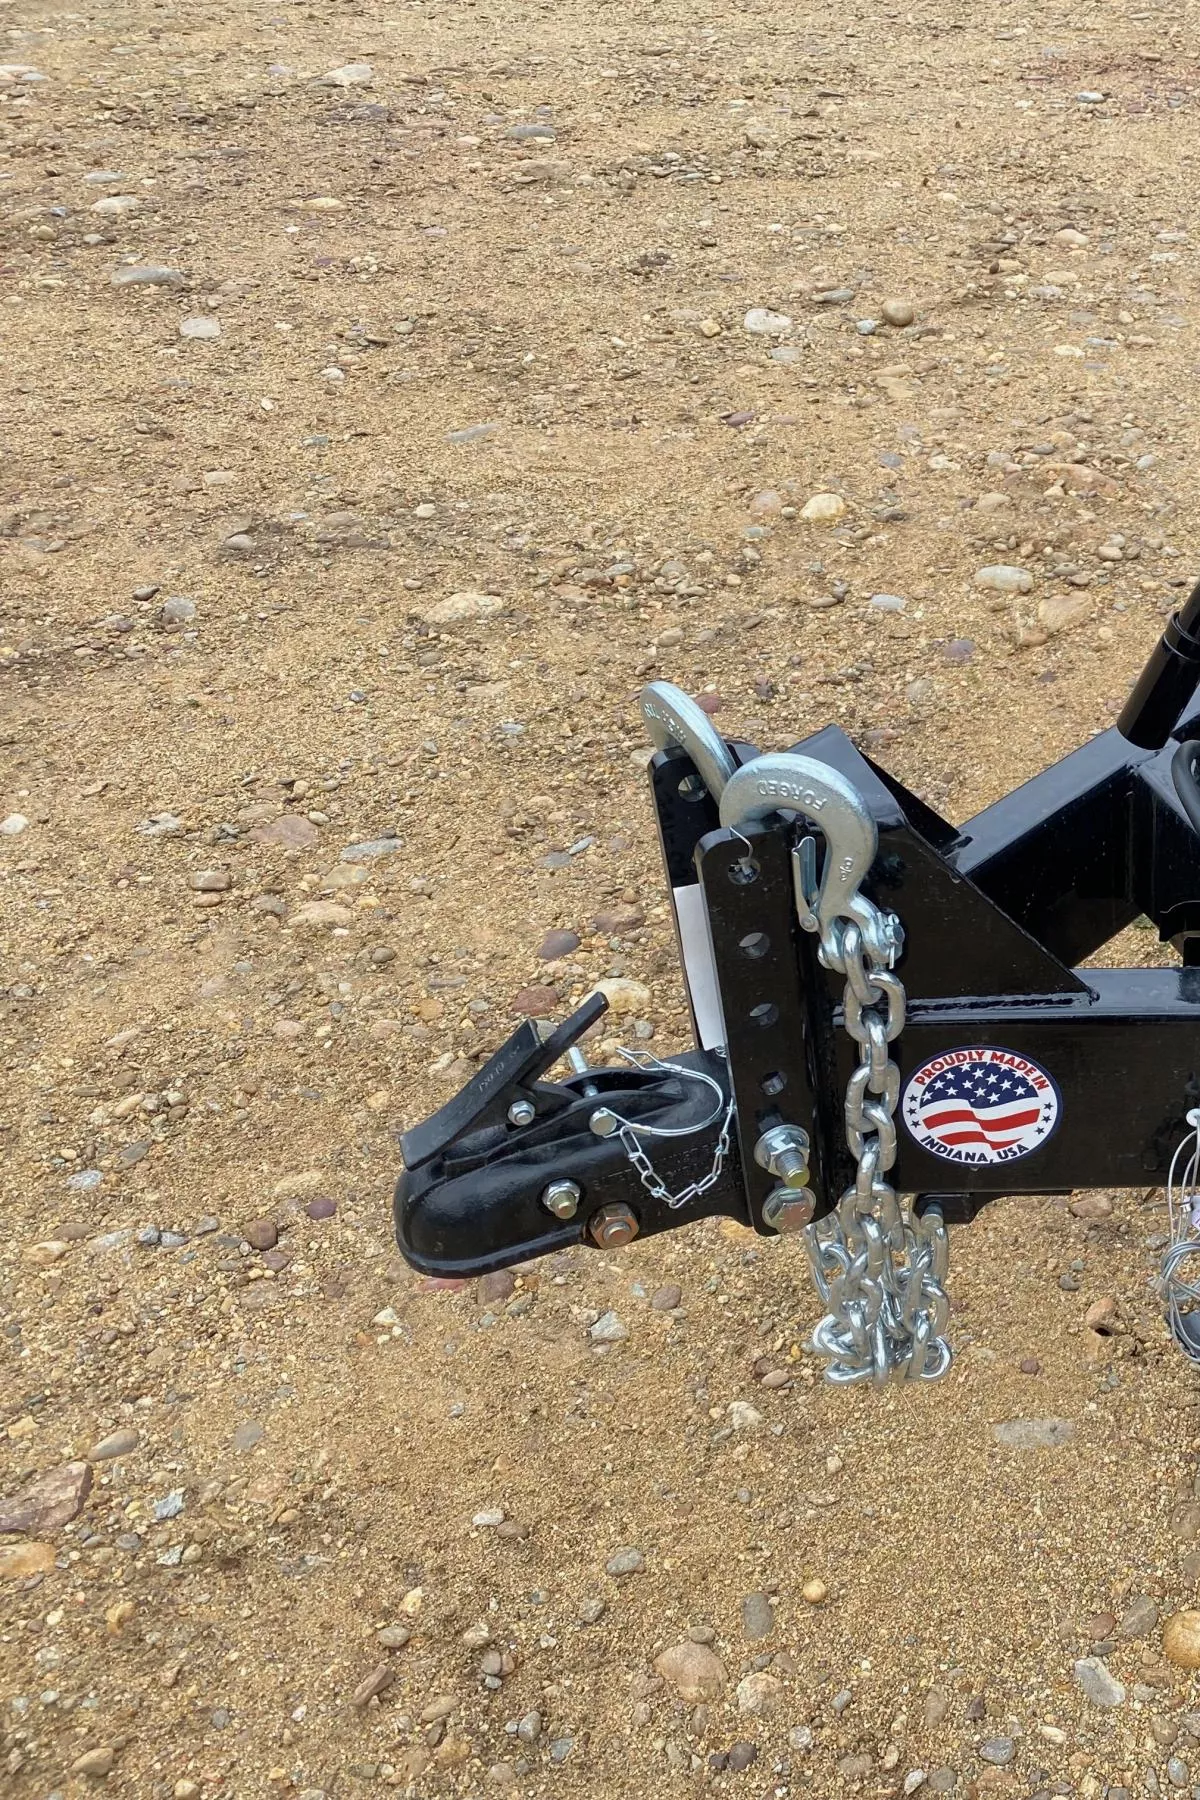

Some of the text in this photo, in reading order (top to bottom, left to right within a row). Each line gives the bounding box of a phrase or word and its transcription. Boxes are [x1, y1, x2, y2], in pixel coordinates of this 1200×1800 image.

[756, 778, 829, 812] FORGED
[914, 1050, 1050, 1091] PROUDLY MADE IN
[920, 1134, 1030, 1163] INDIANA, USA
